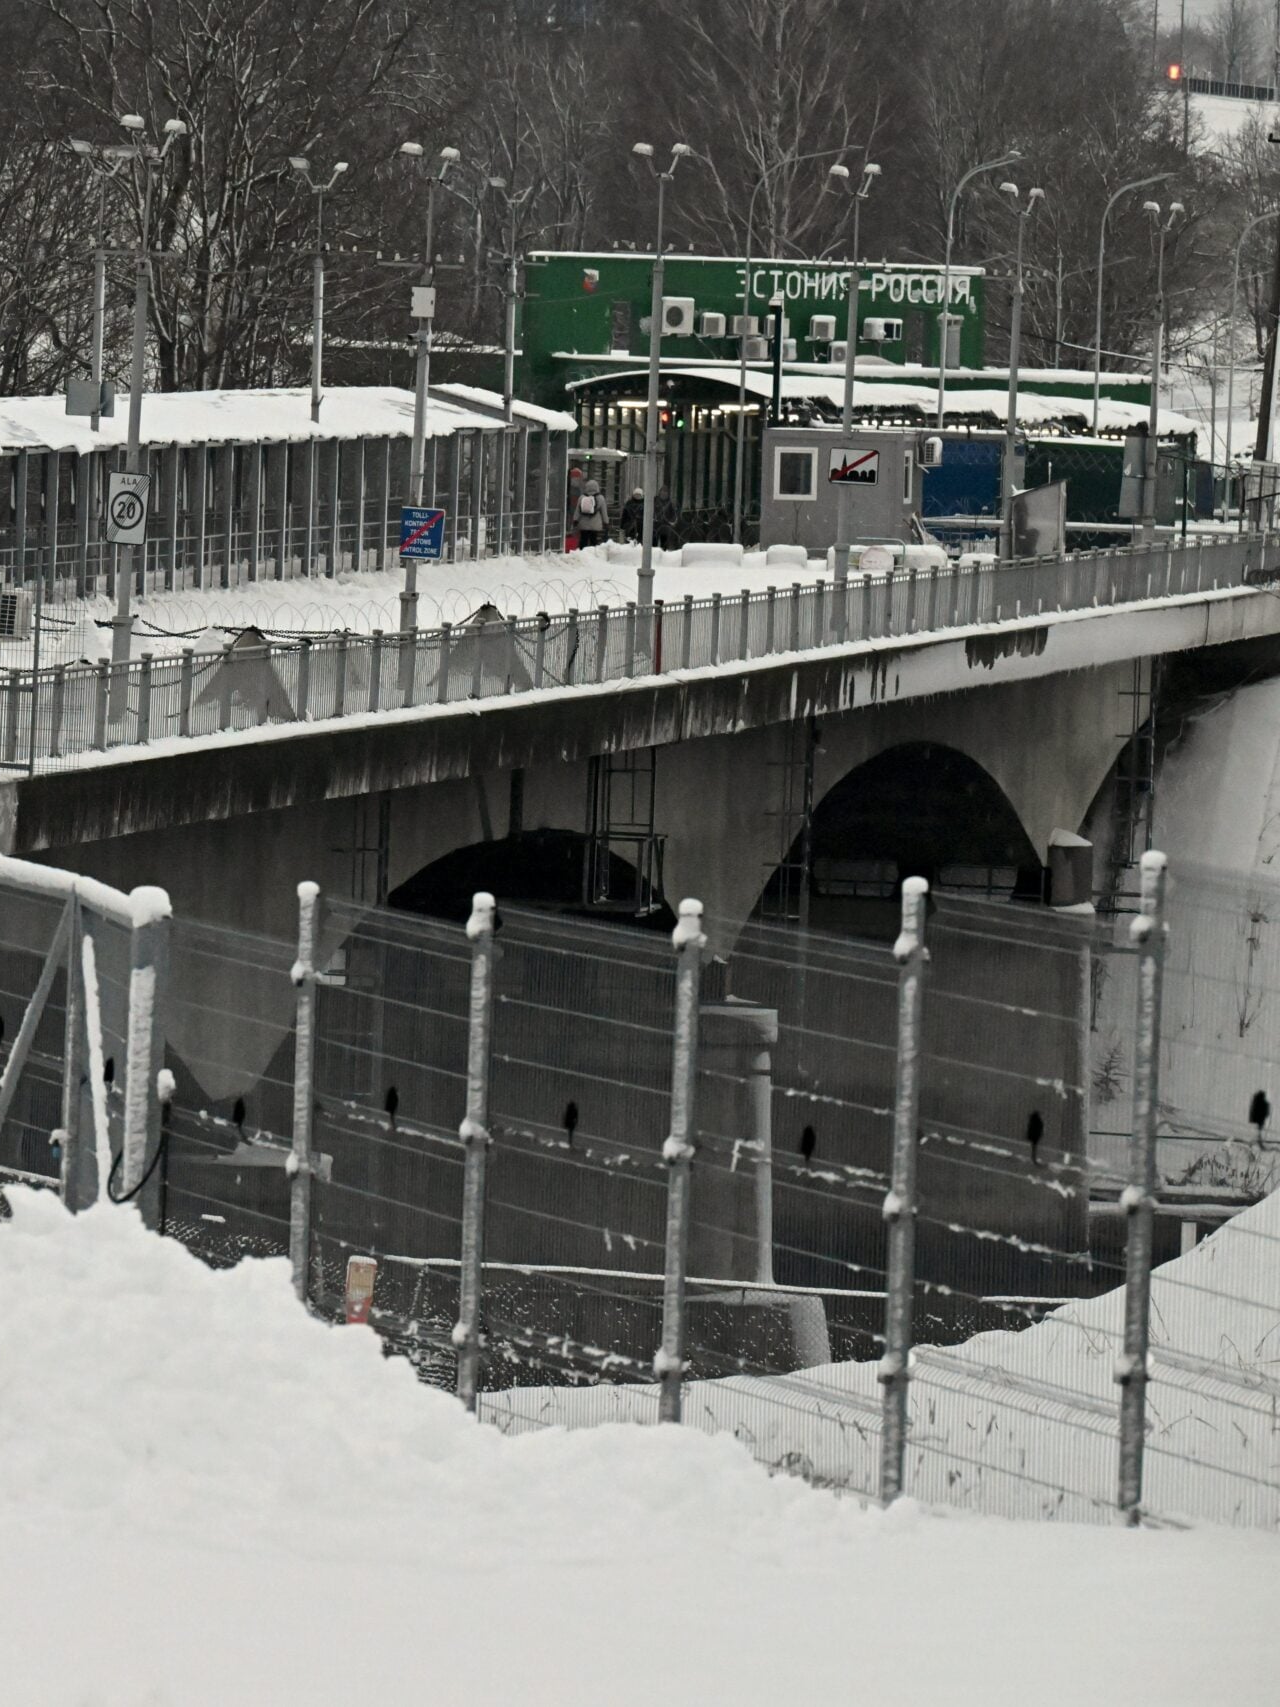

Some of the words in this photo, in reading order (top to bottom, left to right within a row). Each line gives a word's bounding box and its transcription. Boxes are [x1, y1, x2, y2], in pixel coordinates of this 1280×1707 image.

[120, 477, 138, 486] ALA
[116, 501, 136, 520] 20
[404, 520, 435, 528] KONTROLI
[406, 537, 432, 545] CSTOMS
